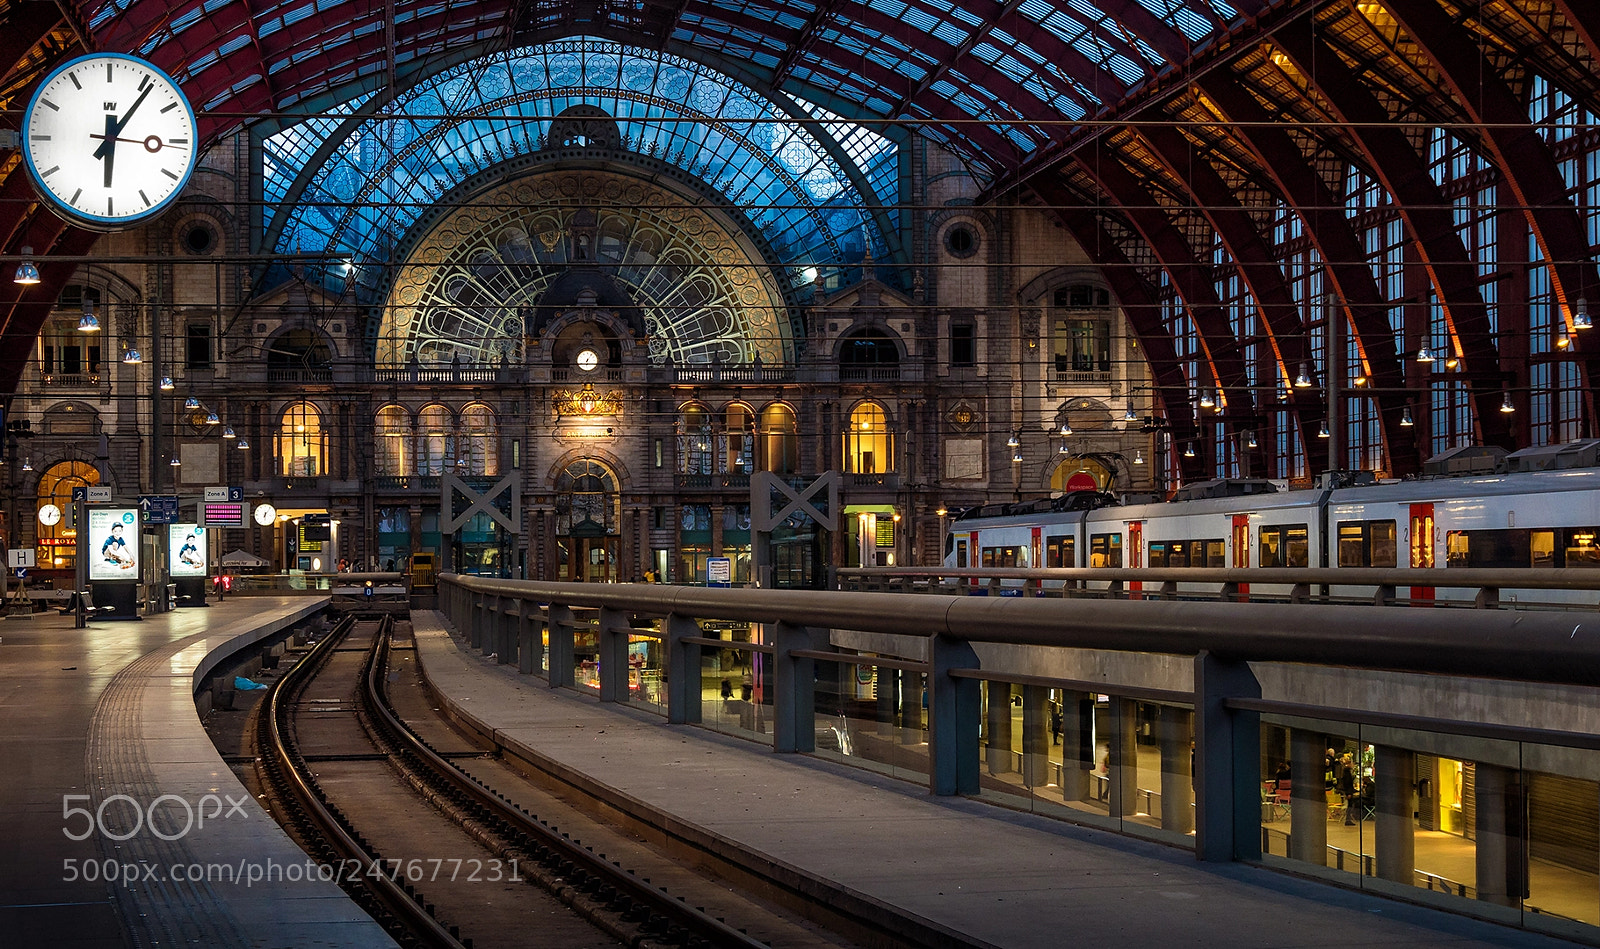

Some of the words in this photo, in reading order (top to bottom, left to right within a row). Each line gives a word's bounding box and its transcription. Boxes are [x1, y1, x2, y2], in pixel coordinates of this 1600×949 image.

[103, 102, 117, 111] W
[232, 491, 239, 499] 3
[1404, 528, 1408, 542] 2
[1436, 527, 1441, 542] 2
[17, 551, 26, 564] H
